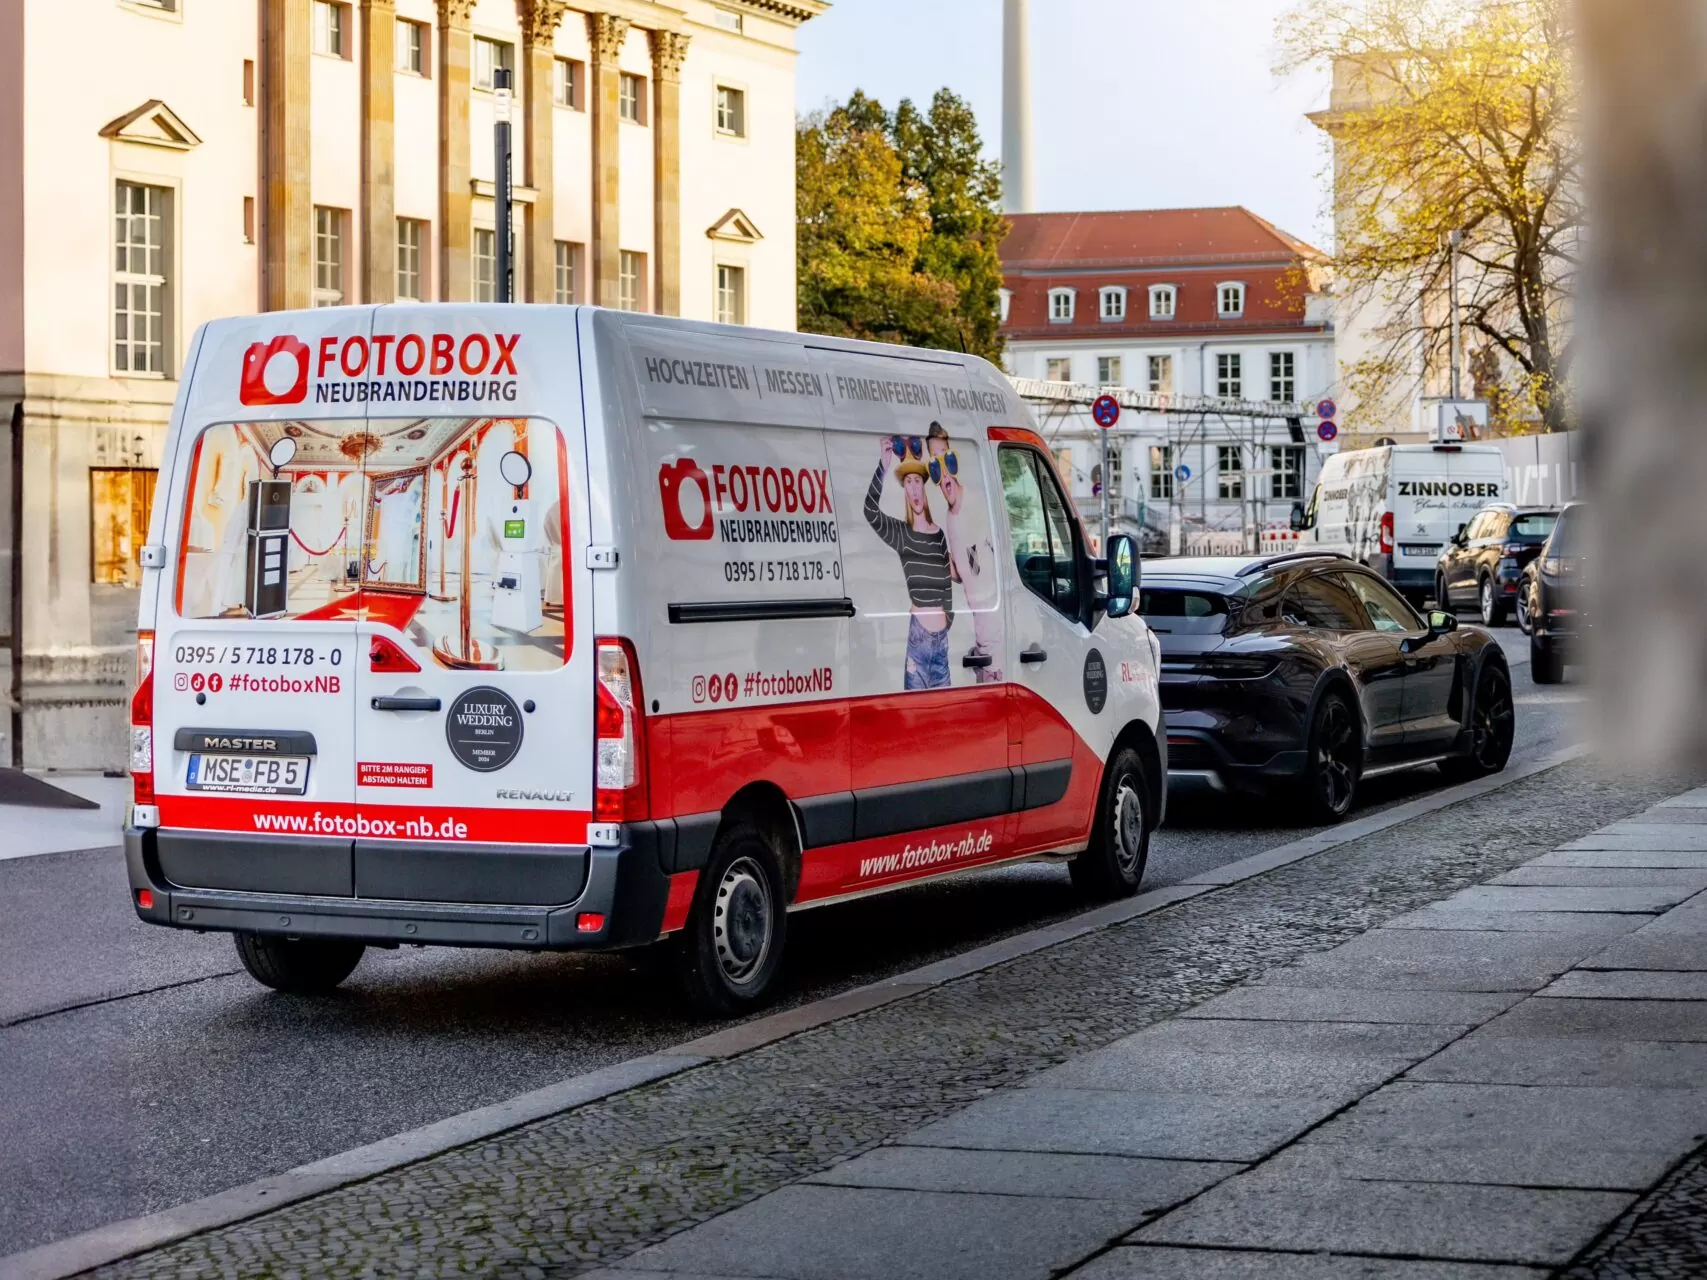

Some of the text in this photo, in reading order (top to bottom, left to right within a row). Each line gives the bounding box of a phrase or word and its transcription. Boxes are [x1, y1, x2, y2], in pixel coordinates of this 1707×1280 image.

[317, 333, 521, 378] FOTOBOX
[316, 380, 518, 403] NEUBRANDENBURG
[644, 357, 750, 391] HOCHZEITEN
[765, 368, 824, 396] MESSEN
[836, 376, 931, 407] FIRMENFEIERN
[941, 386, 1007, 414] TAGUNGEN
[712, 464, 833, 513] FOTOBOX
[1398, 482, 1499, 497] ZINNOBER
[720, 519, 837, 543] NEUBRANDENBURG
[724, 561, 756, 582] 0395
[767, 562, 775, 581] 5
[777, 561, 800, 581] 718
[802, 561, 824, 581] 178
[833, 561, 841, 580] 0
[175, 646, 215, 664] 0395
[230, 647, 241, 664] 5
[246, 647, 277, 665] 718
[282, 648, 314, 665] 178
[330, 648, 342, 666] 0
[229, 673, 341, 693] #fotoboxNB
[743, 667, 833, 698] #fotoboxNB
[464, 703, 507, 715] LUXURY
[457, 714, 513, 726] WEDDING
[204, 737, 278, 750] MASTER
[204, 758, 299, 785] MSE FB 5
[361, 764, 429, 774] BITTE 2M RANGIER-
[362, 775, 428, 785] ABSTAND HALTEN!
[496, 788, 574, 802] RENAULT
[253, 811, 468, 838] www.fotobox-nb.de
[859, 829, 993, 877] www.fotobox-nb.de
